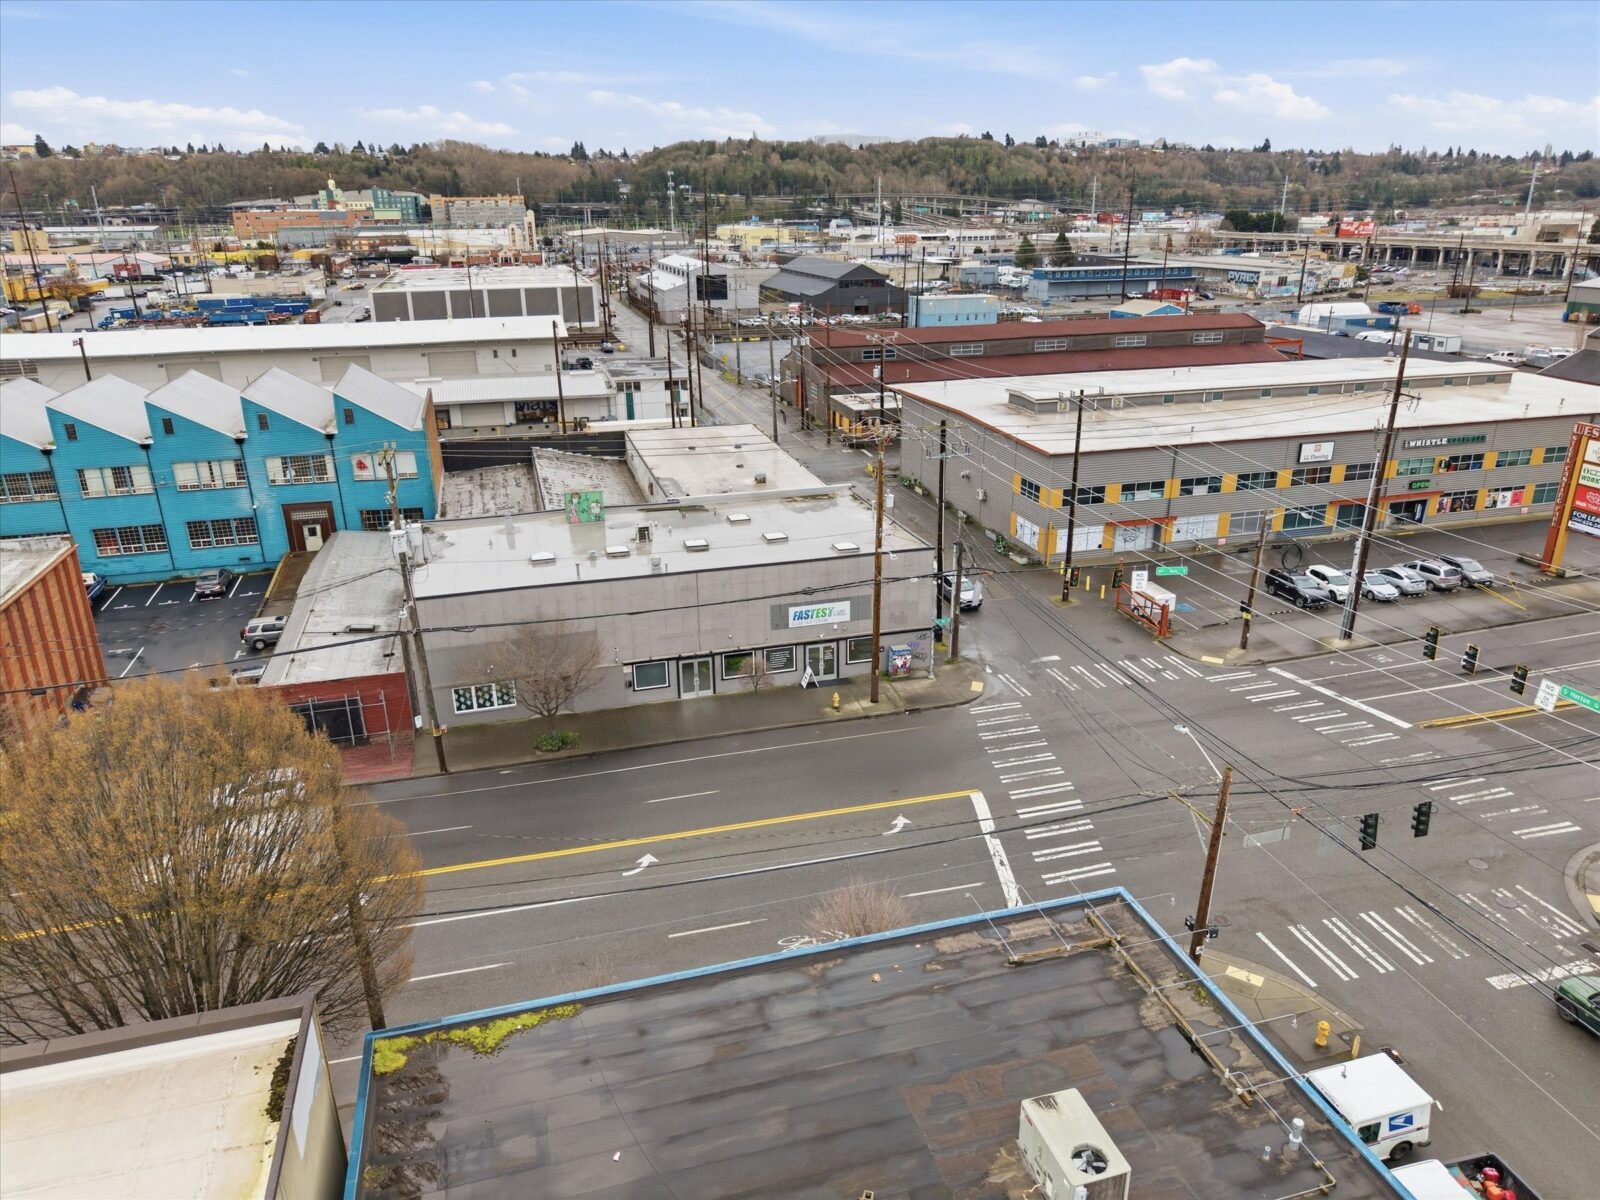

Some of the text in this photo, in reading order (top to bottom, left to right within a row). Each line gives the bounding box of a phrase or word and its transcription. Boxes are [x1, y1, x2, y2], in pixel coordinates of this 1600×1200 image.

[1408, 437, 1447, 448] WHISTLE
[1411, 481, 1429, 489] OPEN
[1572, 510, 1587, 520] FOR
[792, 606, 834, 622] FASTEST
[1544, 684, 1555, 692] NO
